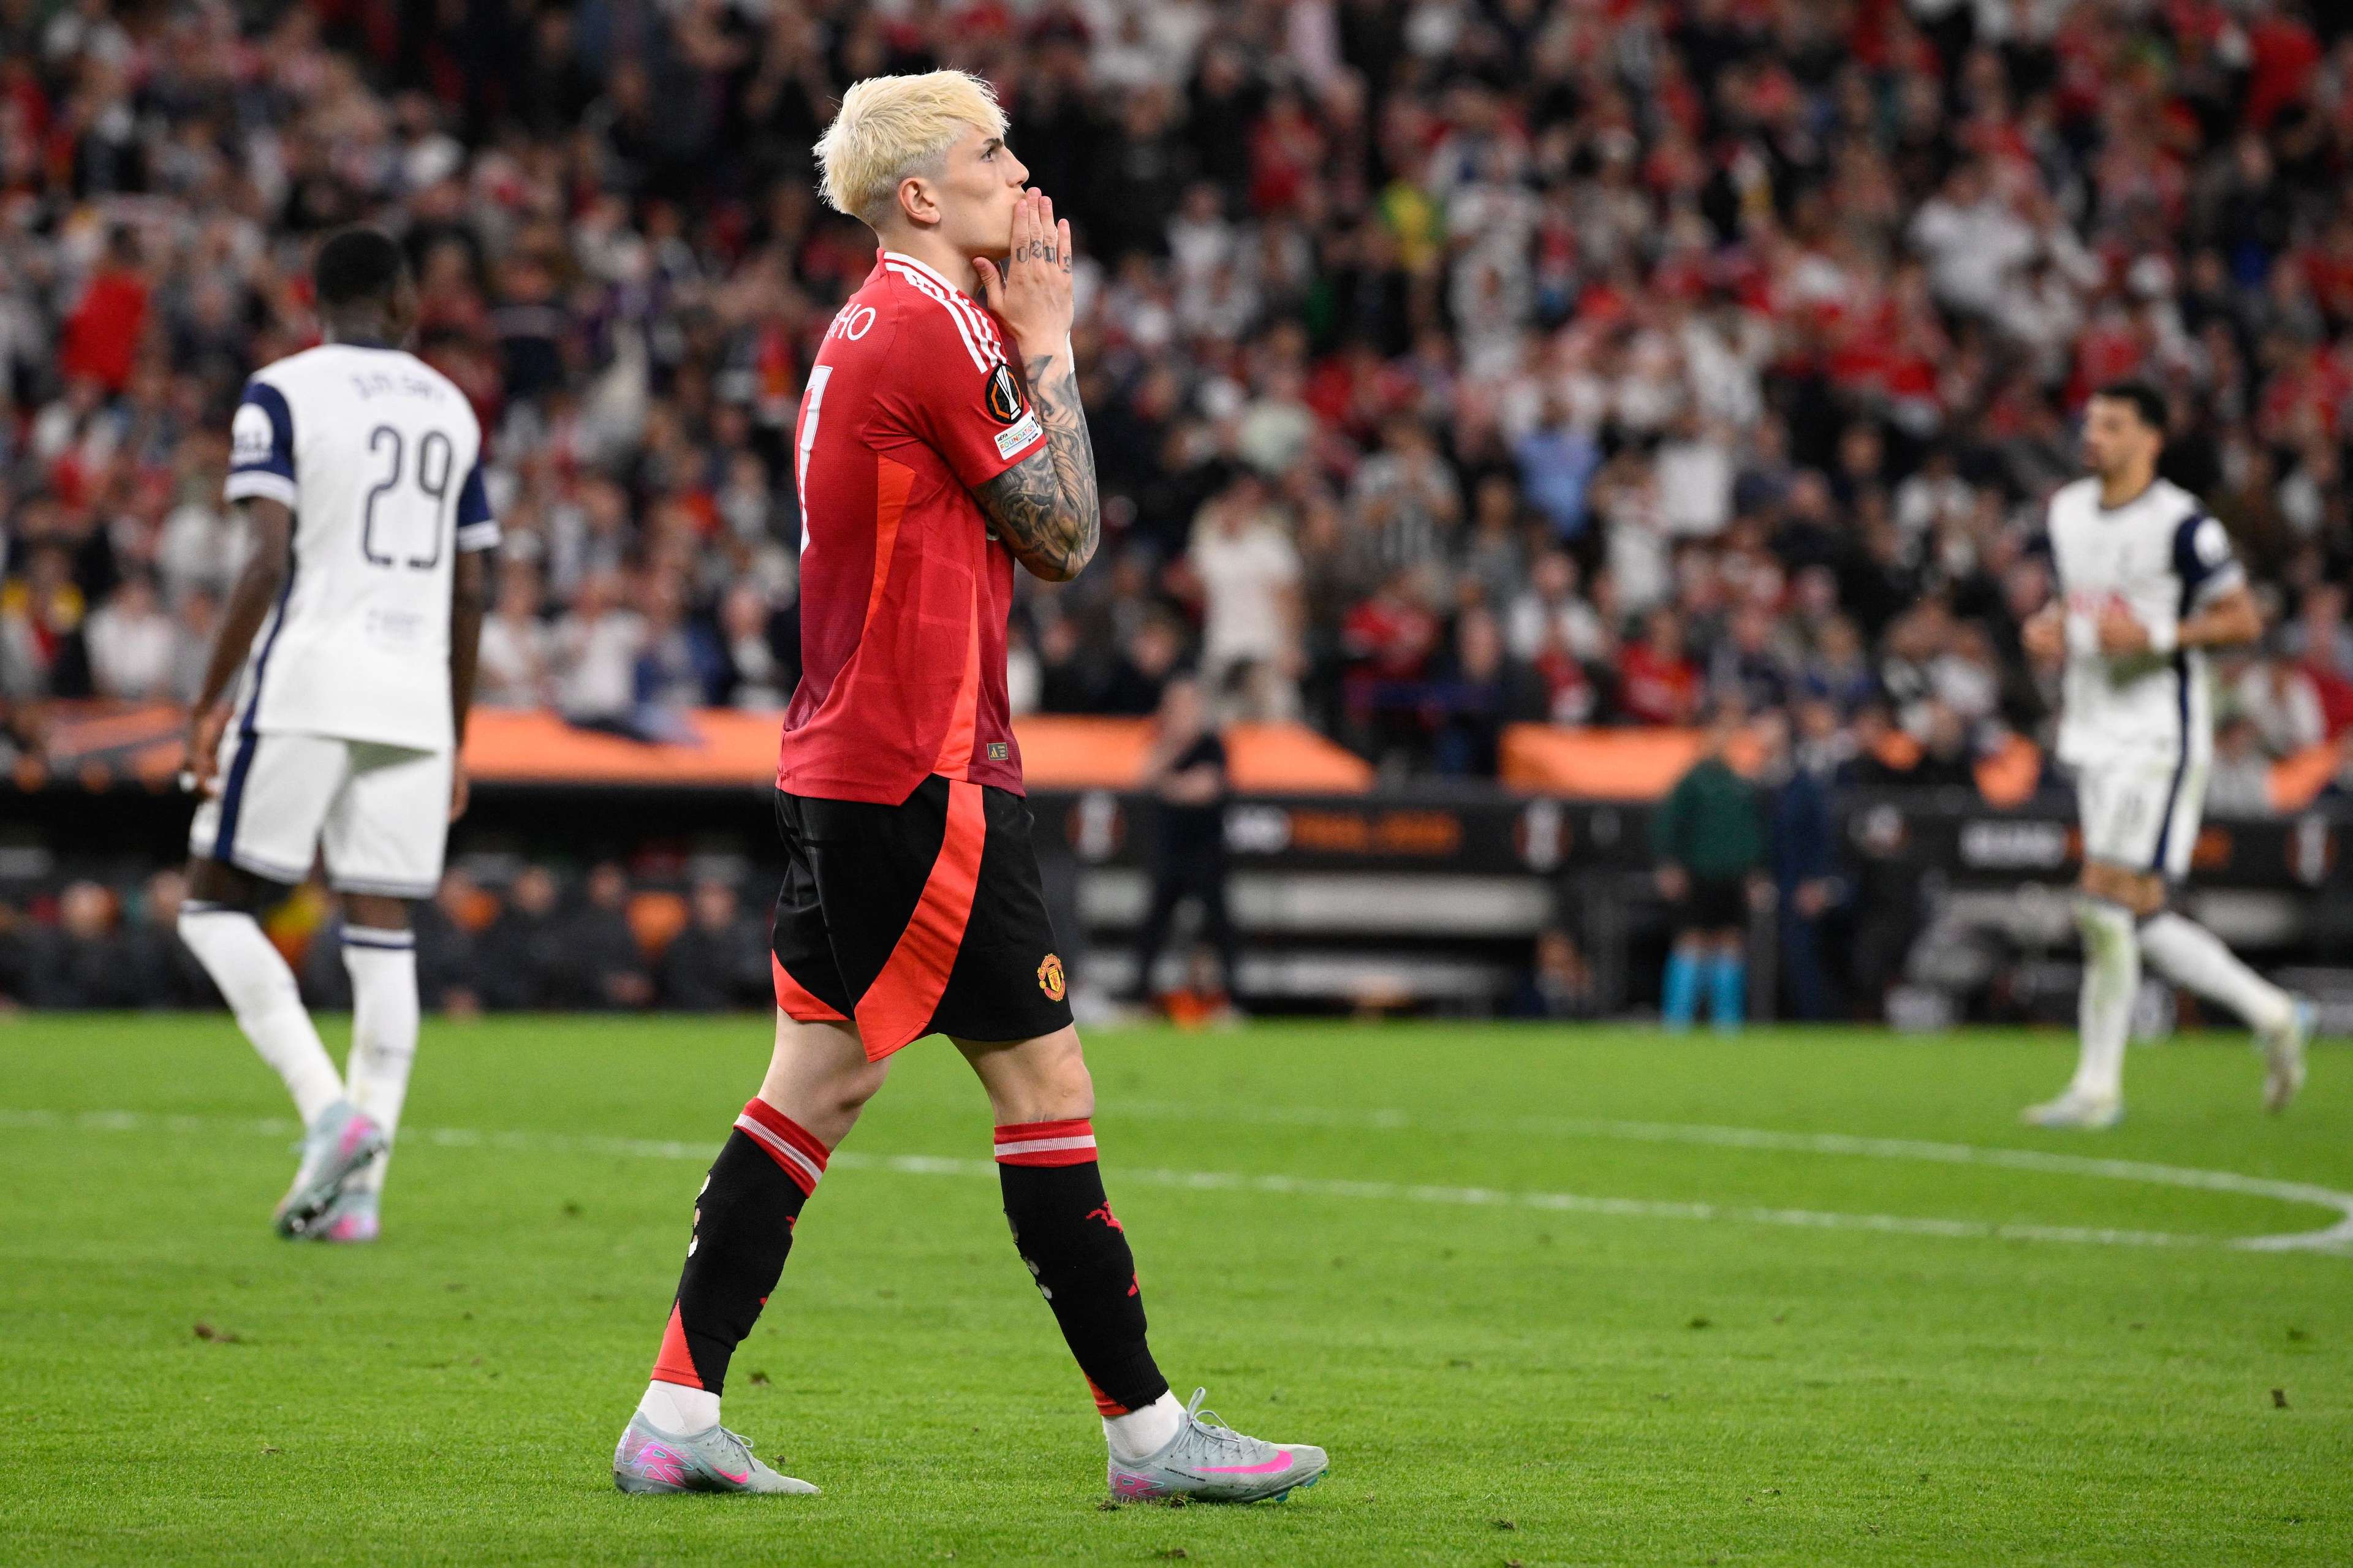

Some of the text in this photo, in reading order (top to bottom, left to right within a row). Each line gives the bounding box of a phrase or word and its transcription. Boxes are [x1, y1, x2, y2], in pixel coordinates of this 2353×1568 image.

[998, 433, 1009, 442] UEFA
[999, 423, 1035, 450] FOUNDATION
[363, 425, 453, 569] 29
